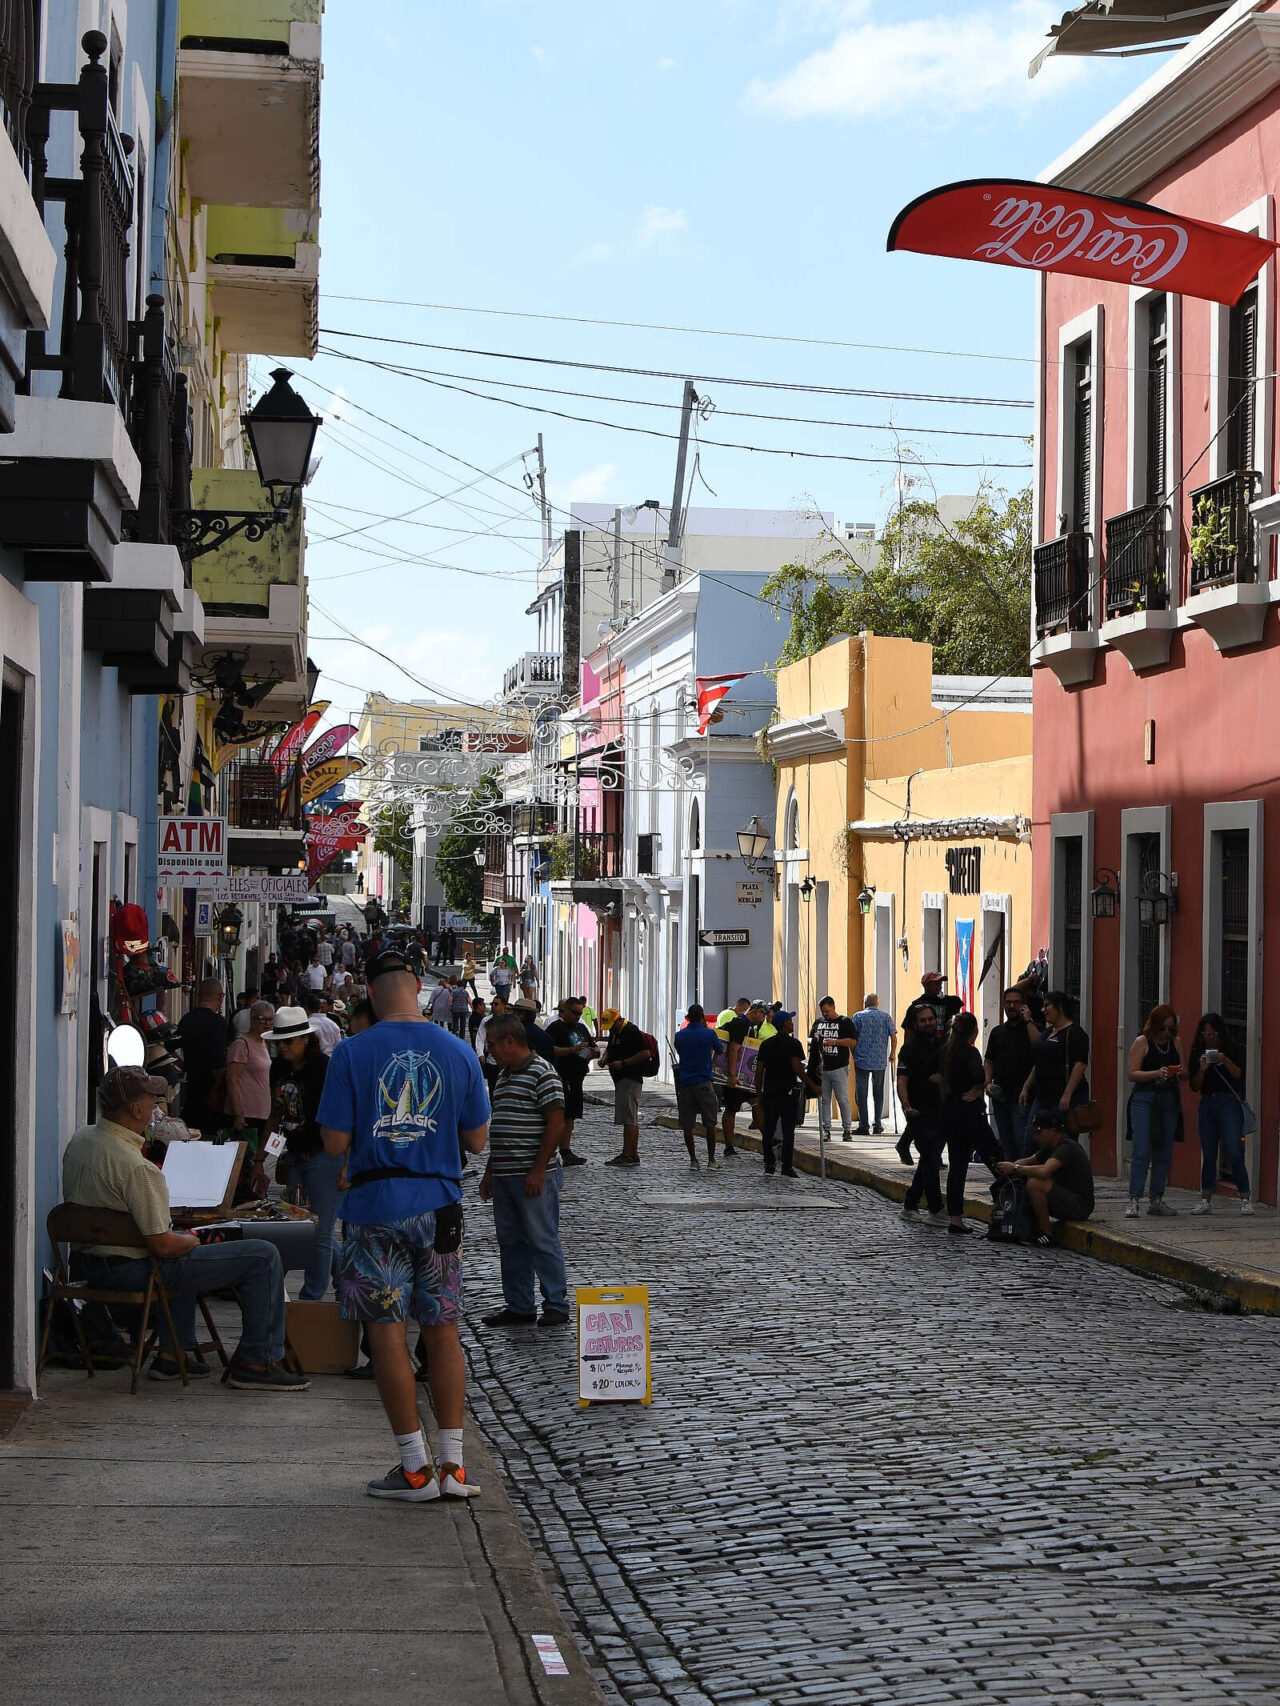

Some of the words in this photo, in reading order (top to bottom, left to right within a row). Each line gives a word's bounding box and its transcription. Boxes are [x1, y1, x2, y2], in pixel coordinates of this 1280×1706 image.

[302, 766, 339, 795] FIREBALL
[162, 822, 221, 852] ATM
[158, 857, 202, 867] Disponible
[205, 857, 223, 867] aquí
[261, 876, 308, 894] OFICIALES
[737, 895, 762, 903] MERCADO
[817, 1022, 839, 1030] SALSA
[585, 1335, 644, 1355] CATURAS
[614, 1380, 636, 1389] COLOR
